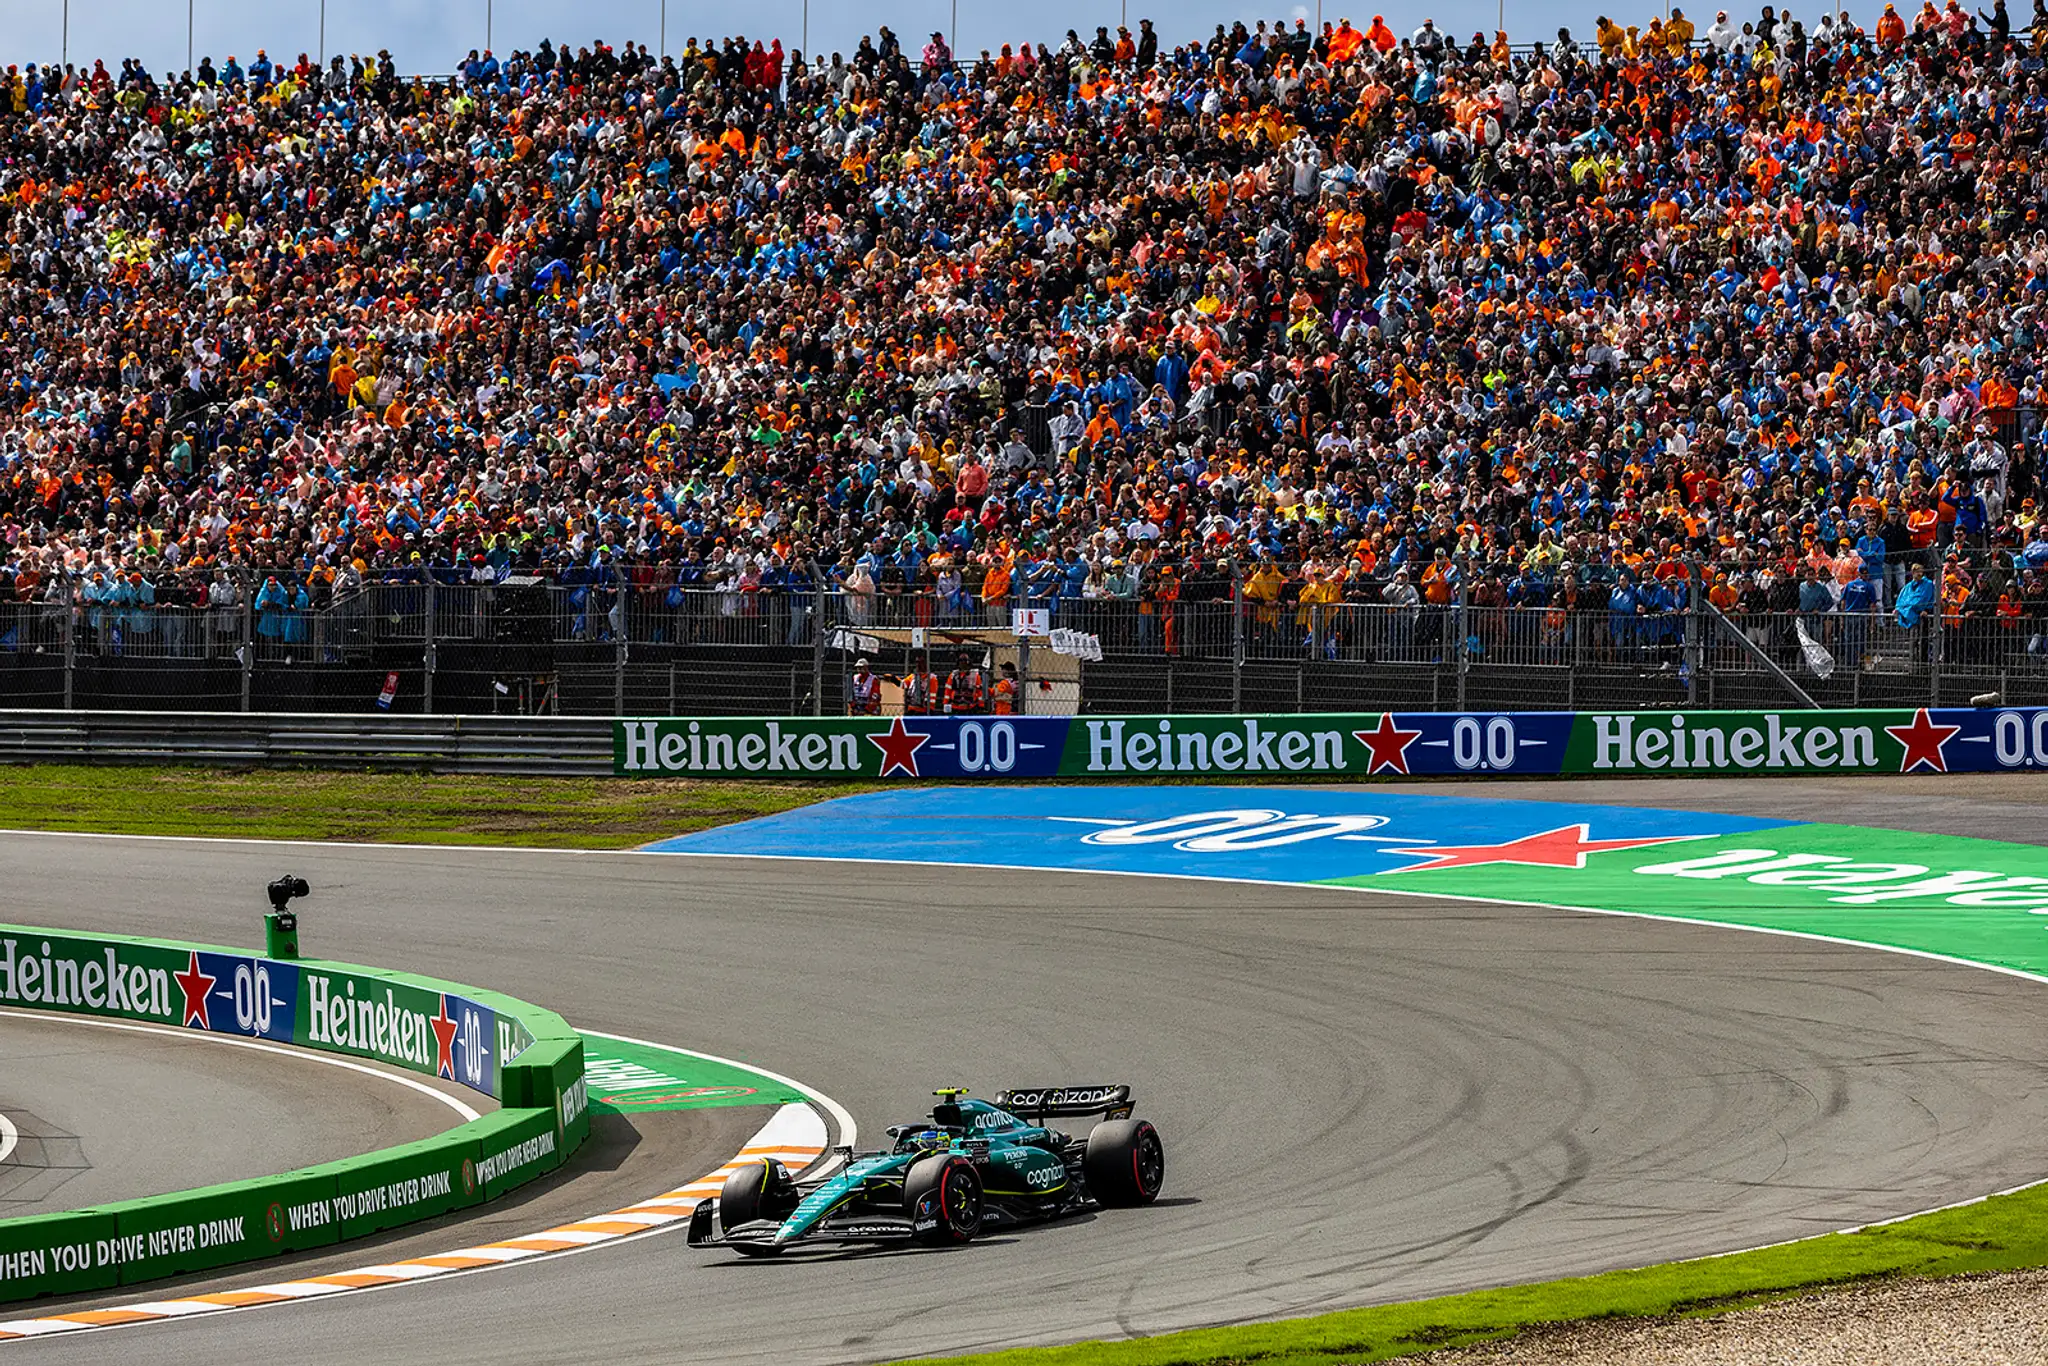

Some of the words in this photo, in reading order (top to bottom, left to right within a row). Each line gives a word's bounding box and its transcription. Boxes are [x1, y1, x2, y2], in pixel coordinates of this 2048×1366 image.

[623, 721, 862, 771] Heineken
[959, 720, 1016, 772] 0.0
[1086, 719, 1347, 771] Heineken
[1452, 716, 1516, 770] 0.0
[1592, 714, 1879, 768] Heineken
[308, 975, 430, 1065] Heineken
[975, 1110, 1014, 1129] aramco
[476, 1156, 496, 1185] WHEN
[496, 1151, 507, 1176] YOU
[522, 1137, 539, 1164] NEVER
[288, 1200, 330, 1231] WHEN
[333, 1194, 356, 1221] YOU
[358, 1186, 386, 1215] DRIVE
[388, 1178, 419, 1209] NEVER
[420, 1170, 451, 1200] DRINK
[982, 1213, 1000, 1221] ARTIN
[0, 1249, 45, 1280] HEN
[51, 1242, 91, 1273] YOU
[96, 1234, 145, 1266] DRIVE
[149, 1225, 195, 1257] NEVER
[199, 1216, 245, 1248] DRINK
